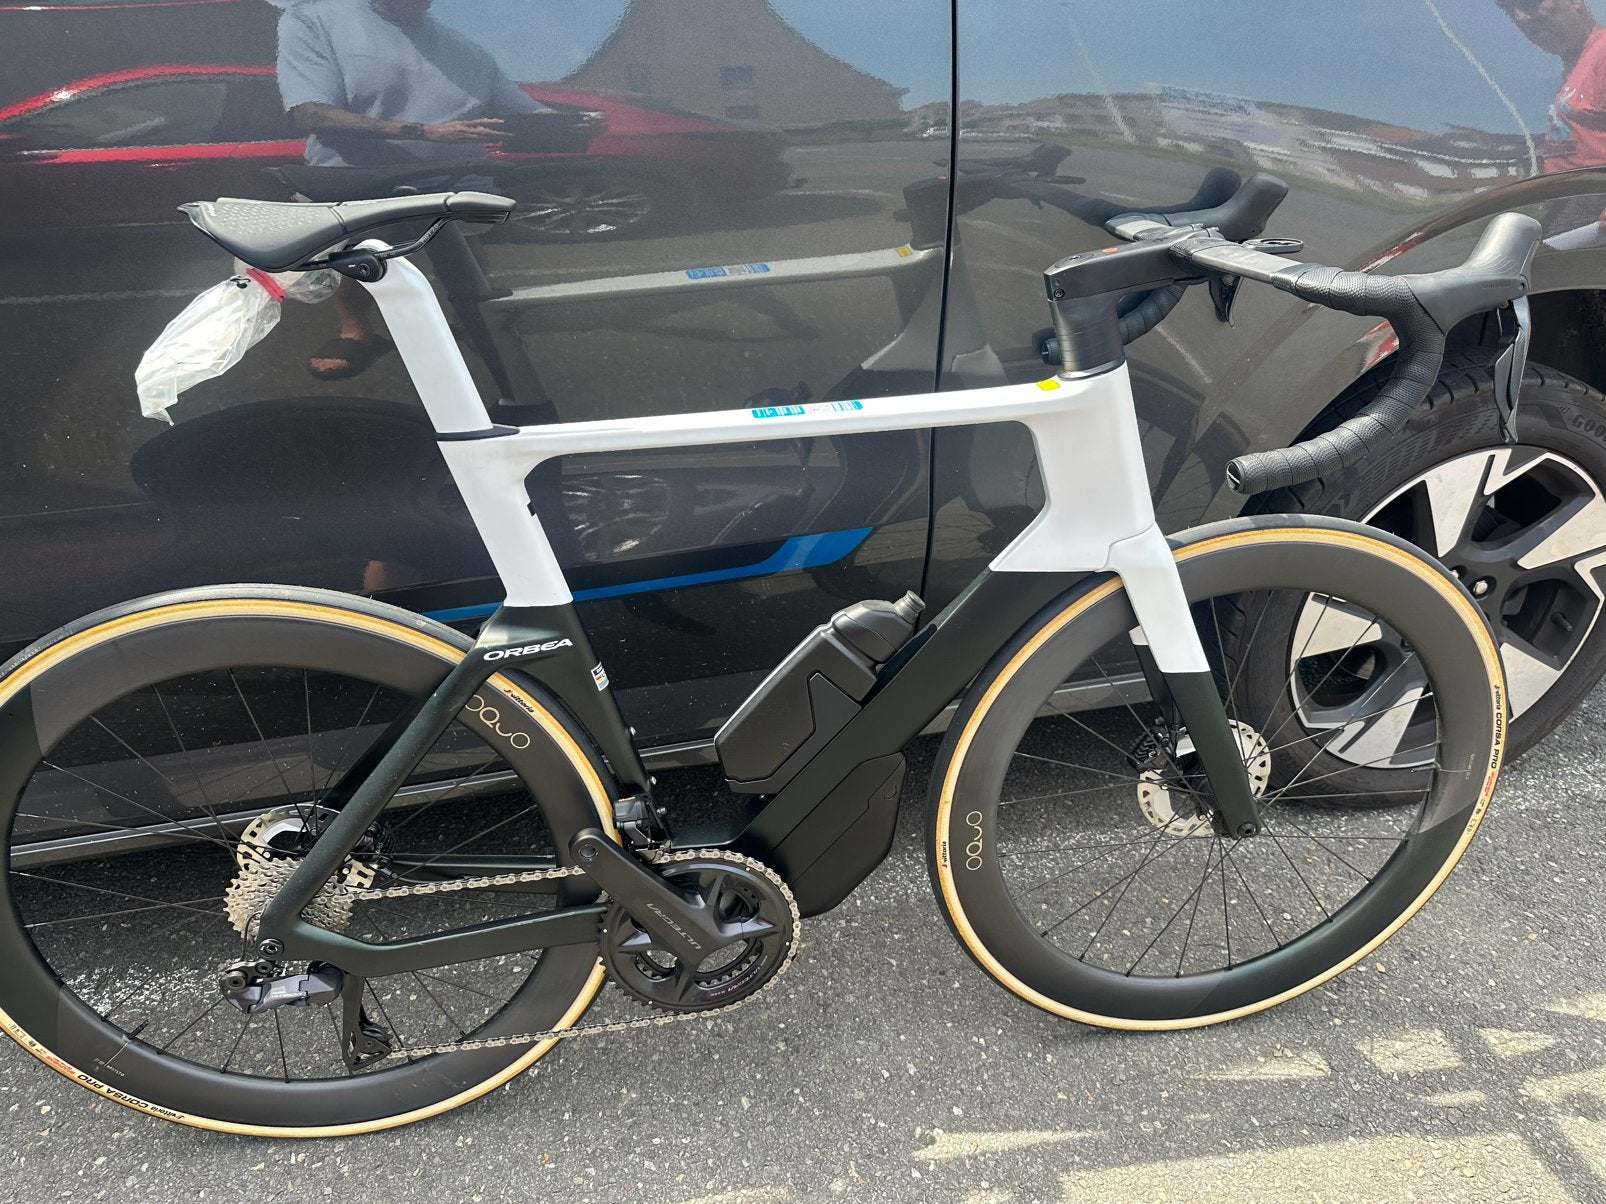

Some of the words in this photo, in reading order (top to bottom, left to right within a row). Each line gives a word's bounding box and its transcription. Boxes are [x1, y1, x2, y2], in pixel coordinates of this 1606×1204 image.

[483, 638, 573, 661] ORBEA
[510, 691, 535, 713] vittoria
[1494, 712, 1503, 746] CORSA
[1490, 748, 1500, 769] PRO
[646, 903, 702, 950] ULTEGRA
[77, 1074, 103, 1089] PRO
[105, 1086, 149, 1109] CORSA
[150, 1105, 178, 1119] vittoria
